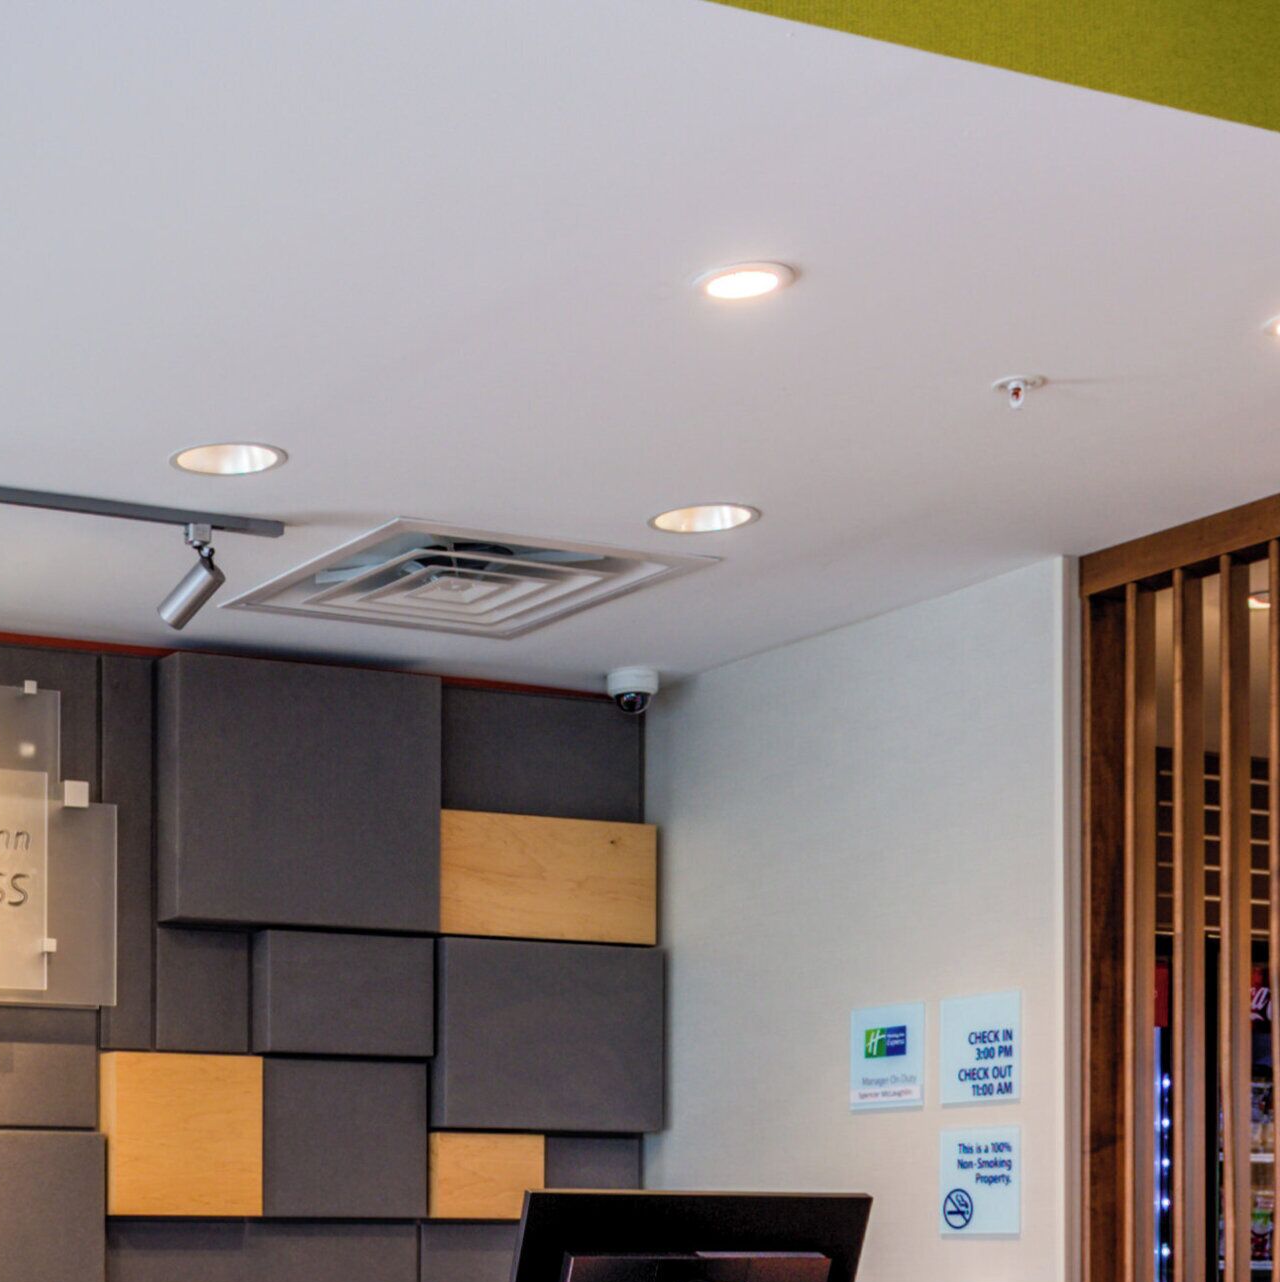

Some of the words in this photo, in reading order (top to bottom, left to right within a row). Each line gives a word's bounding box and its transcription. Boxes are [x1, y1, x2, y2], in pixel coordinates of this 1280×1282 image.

[968, 1030, 1000, 1045] CHECK
[1002, 1029, 1013, 1041] IN
[975, 1047, 995, 1060] 3:00
[998, 1045, 1013, 1057] PM
[958, 1067, 989, 1082] CHECK
[992, 1065, 1013, 1079] OUT
[972, 1083, 994, 1096] 11:00
[996, 1082, 1013, 1095] AM
[957, 1143, 973, 1154] This
[975, 1144, 982, 1154] is
[991, 1142, 1012, 1153] 100%
